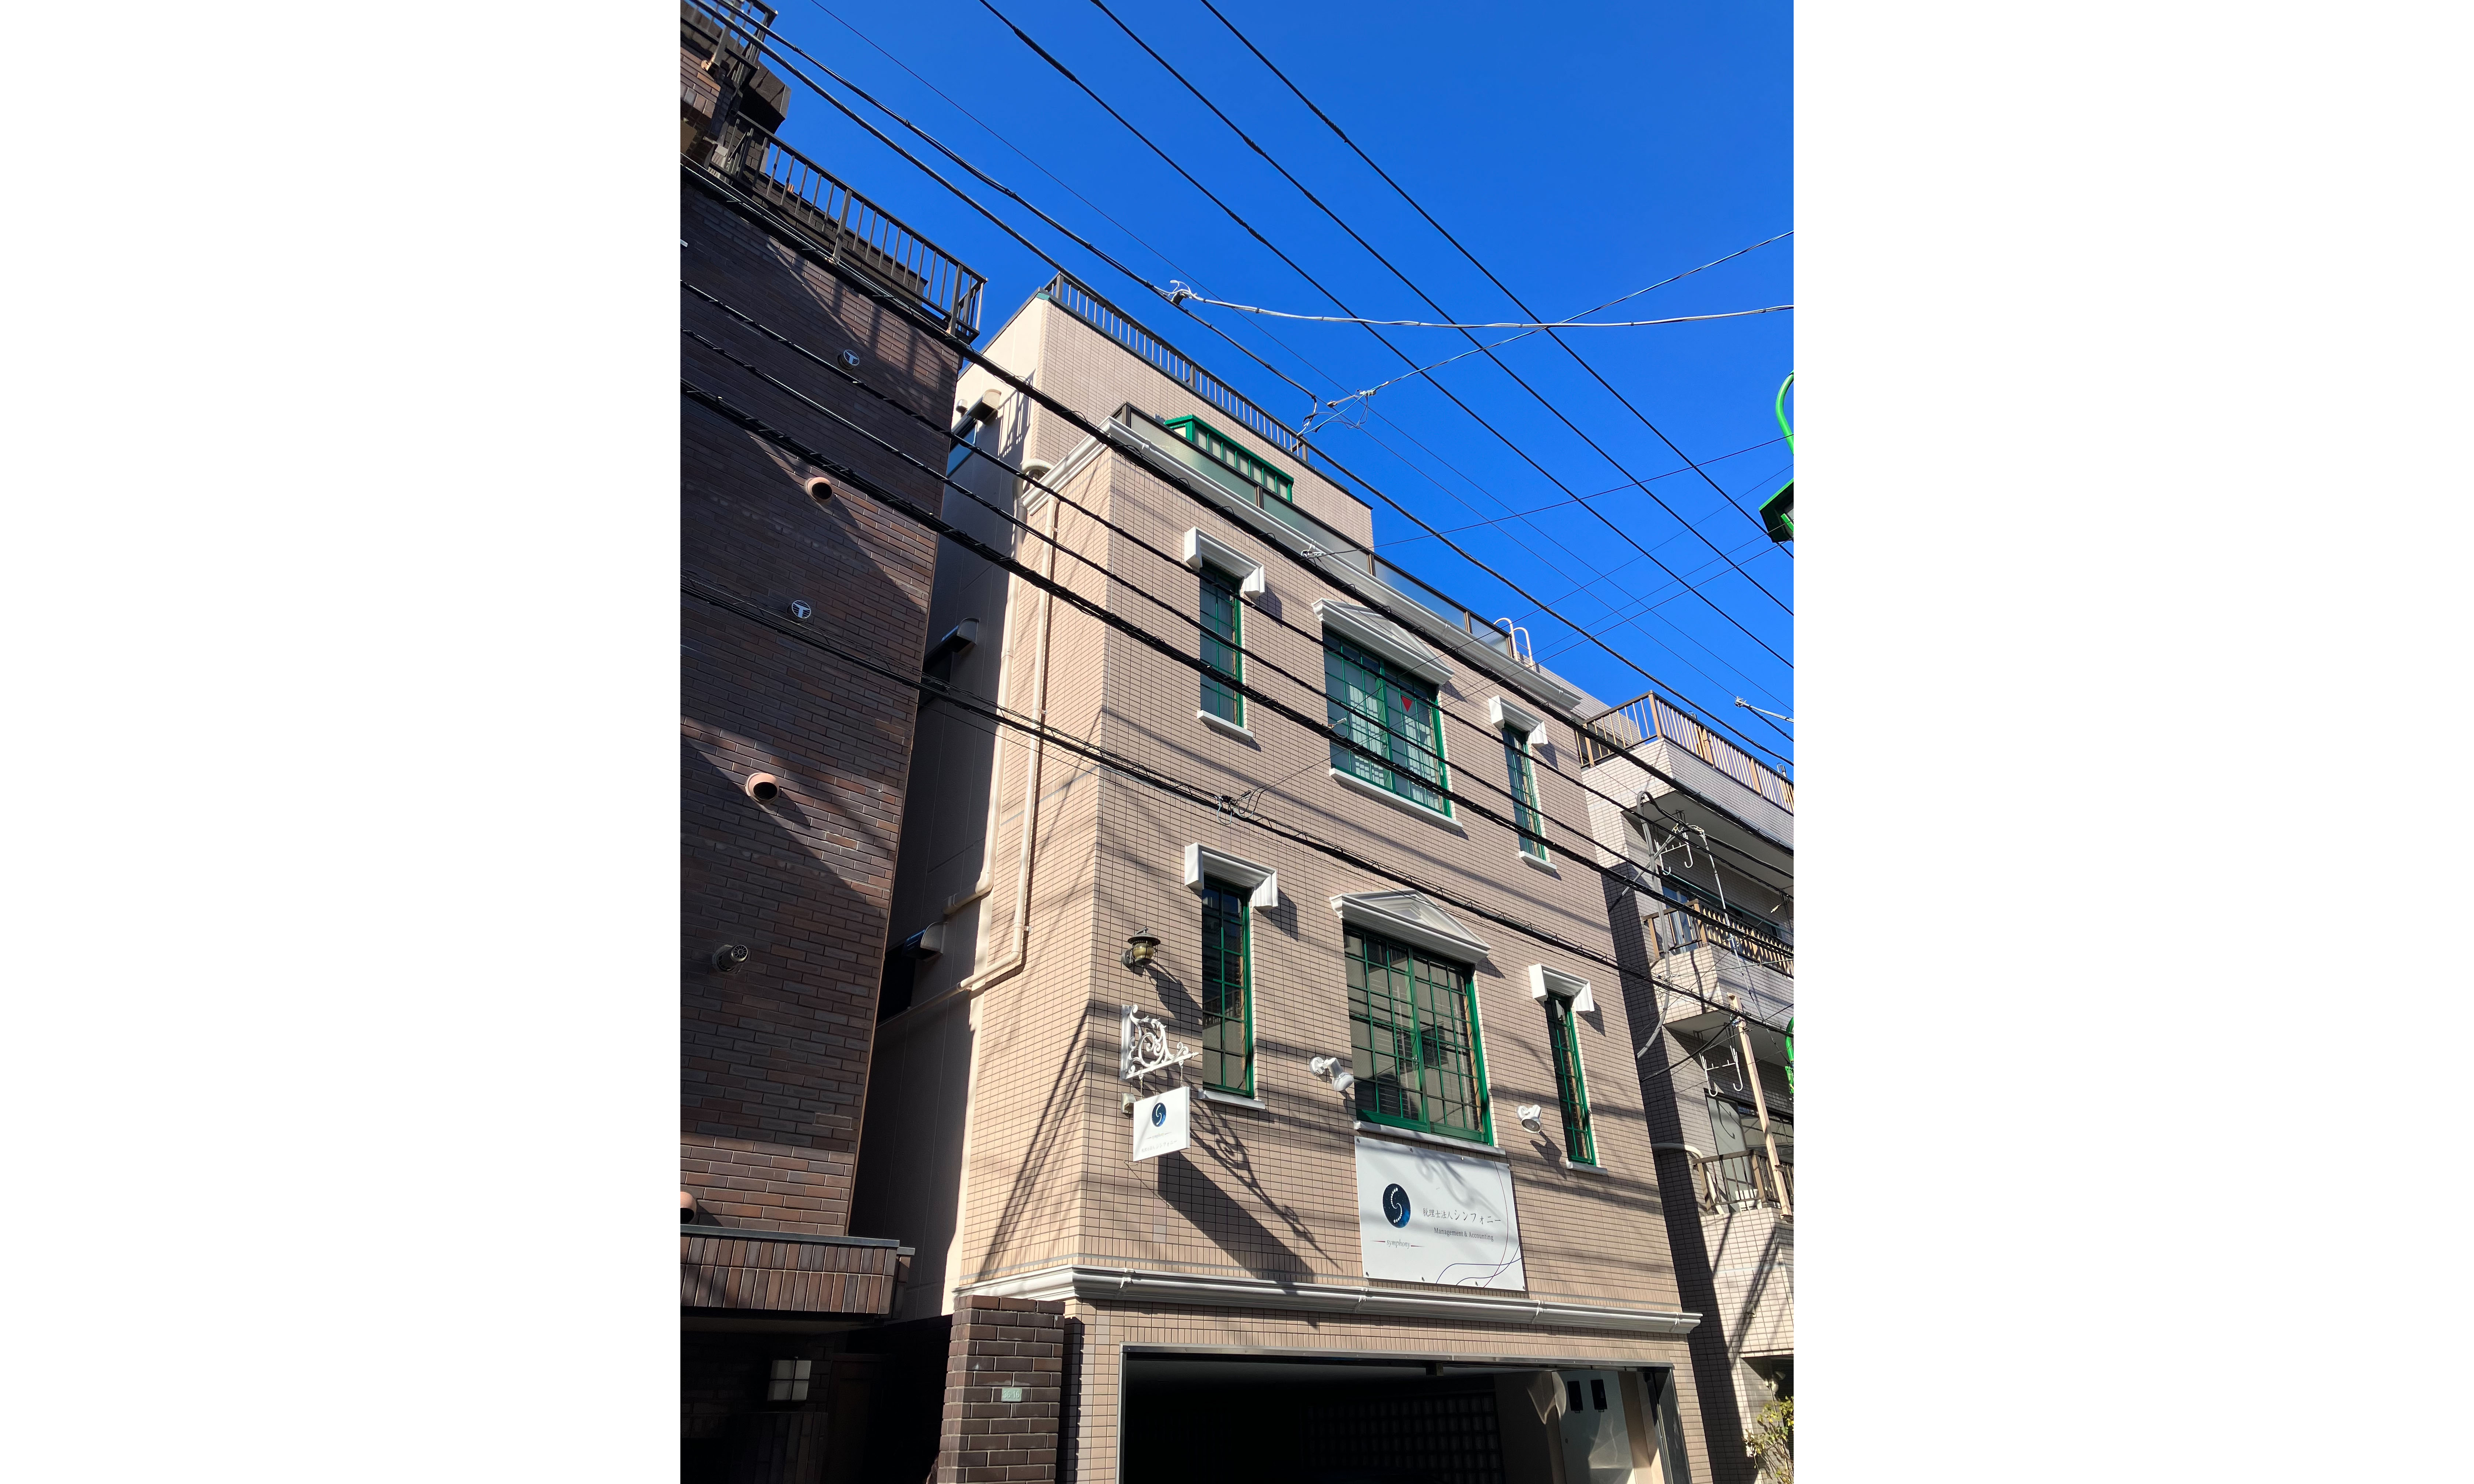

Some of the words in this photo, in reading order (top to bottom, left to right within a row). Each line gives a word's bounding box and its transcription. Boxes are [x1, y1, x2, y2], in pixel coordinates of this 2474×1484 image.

[1423, 1208, 1501, 1225] 税理士法人シンフォニー
[1434, 1227, 1463, 1237] Management
[1469, 1232, 1494, 1241] Accounting
[1387, 1239, 1410, 1249] symphony
